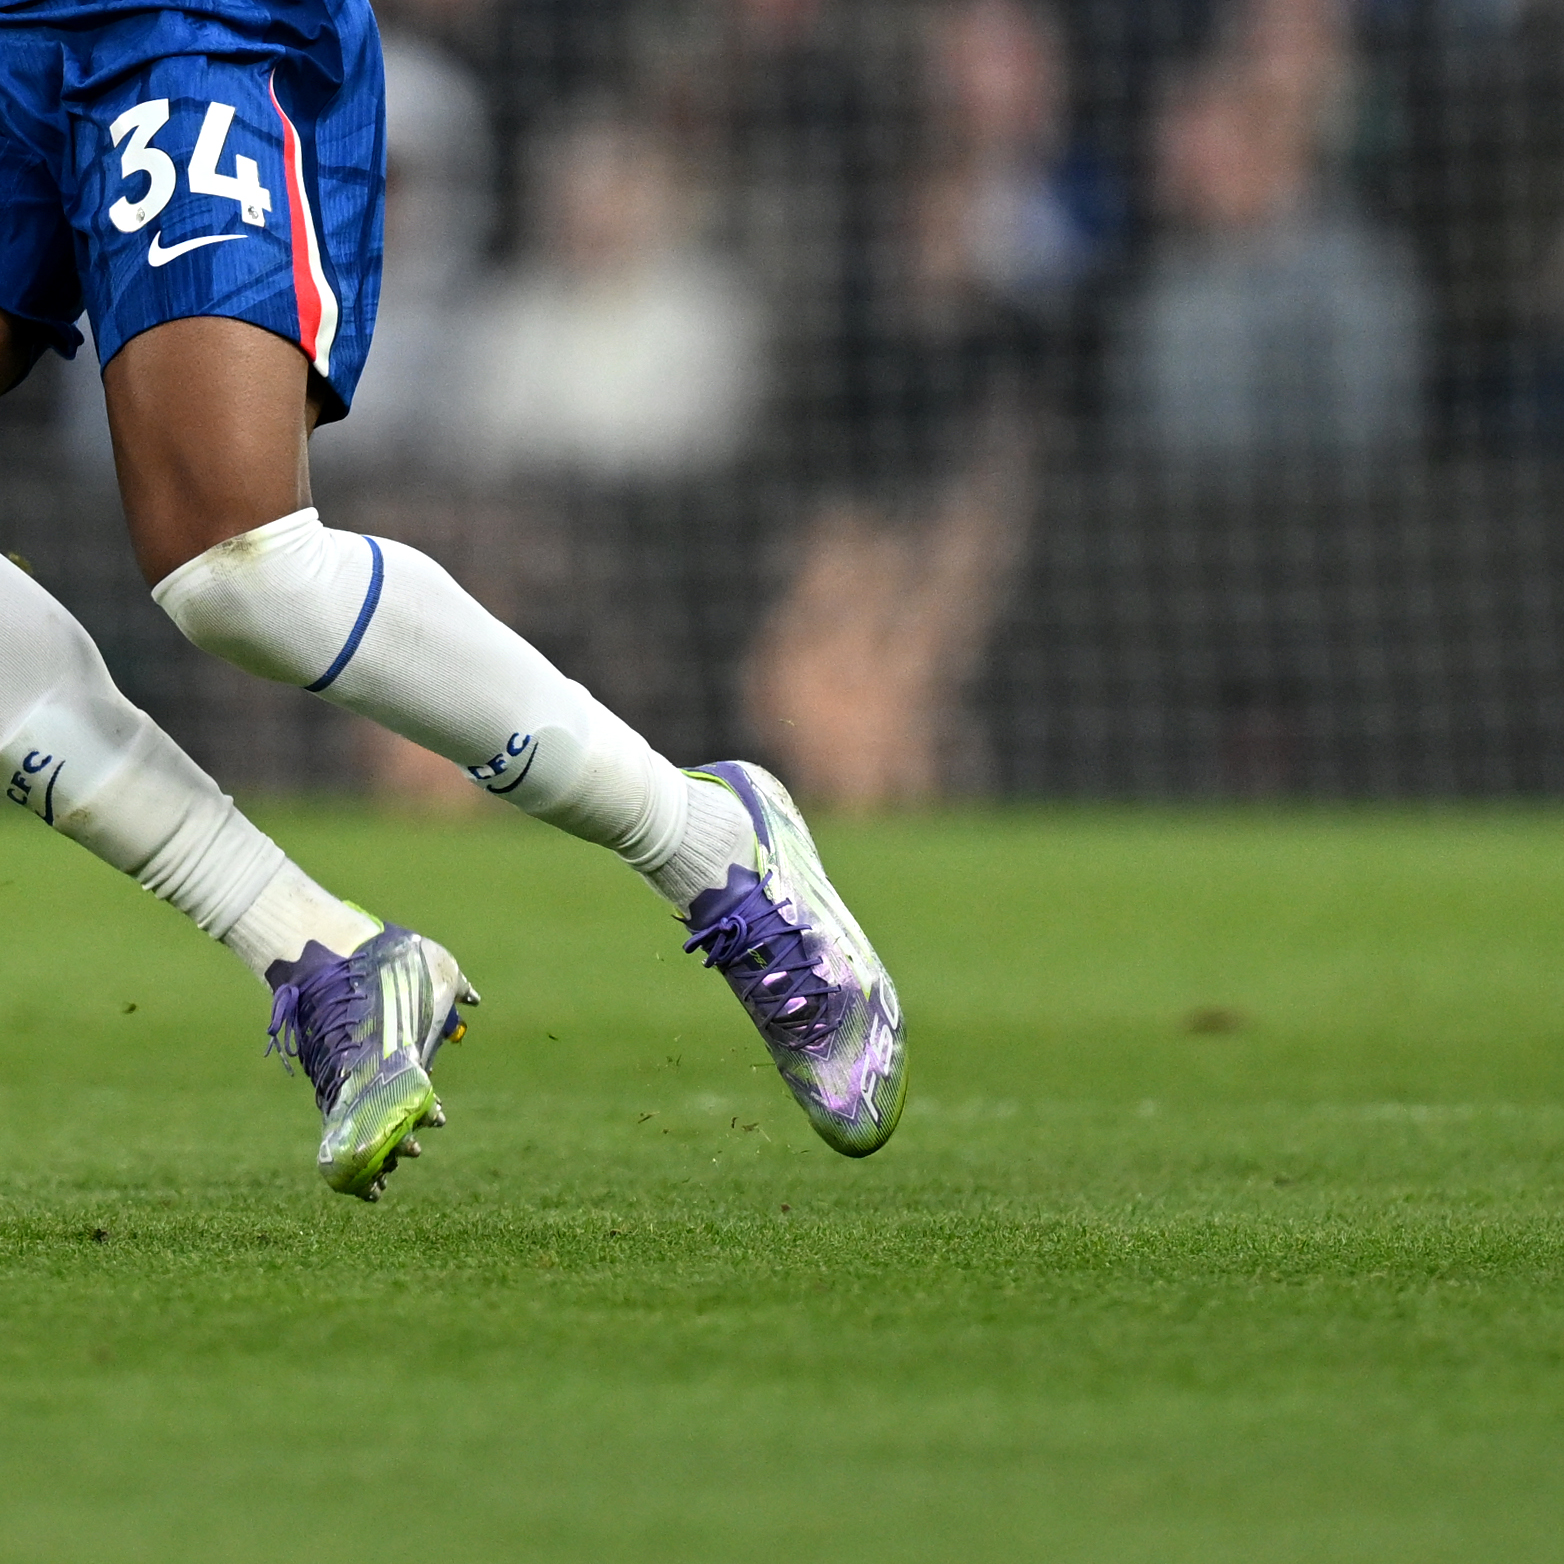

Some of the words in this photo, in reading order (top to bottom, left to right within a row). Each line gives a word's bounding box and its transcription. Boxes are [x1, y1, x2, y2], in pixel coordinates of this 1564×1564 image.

[108, 97, 272, 233] 34
[6, 749, 53, 806] CFC
[467, 732, 532, 780] CFC
